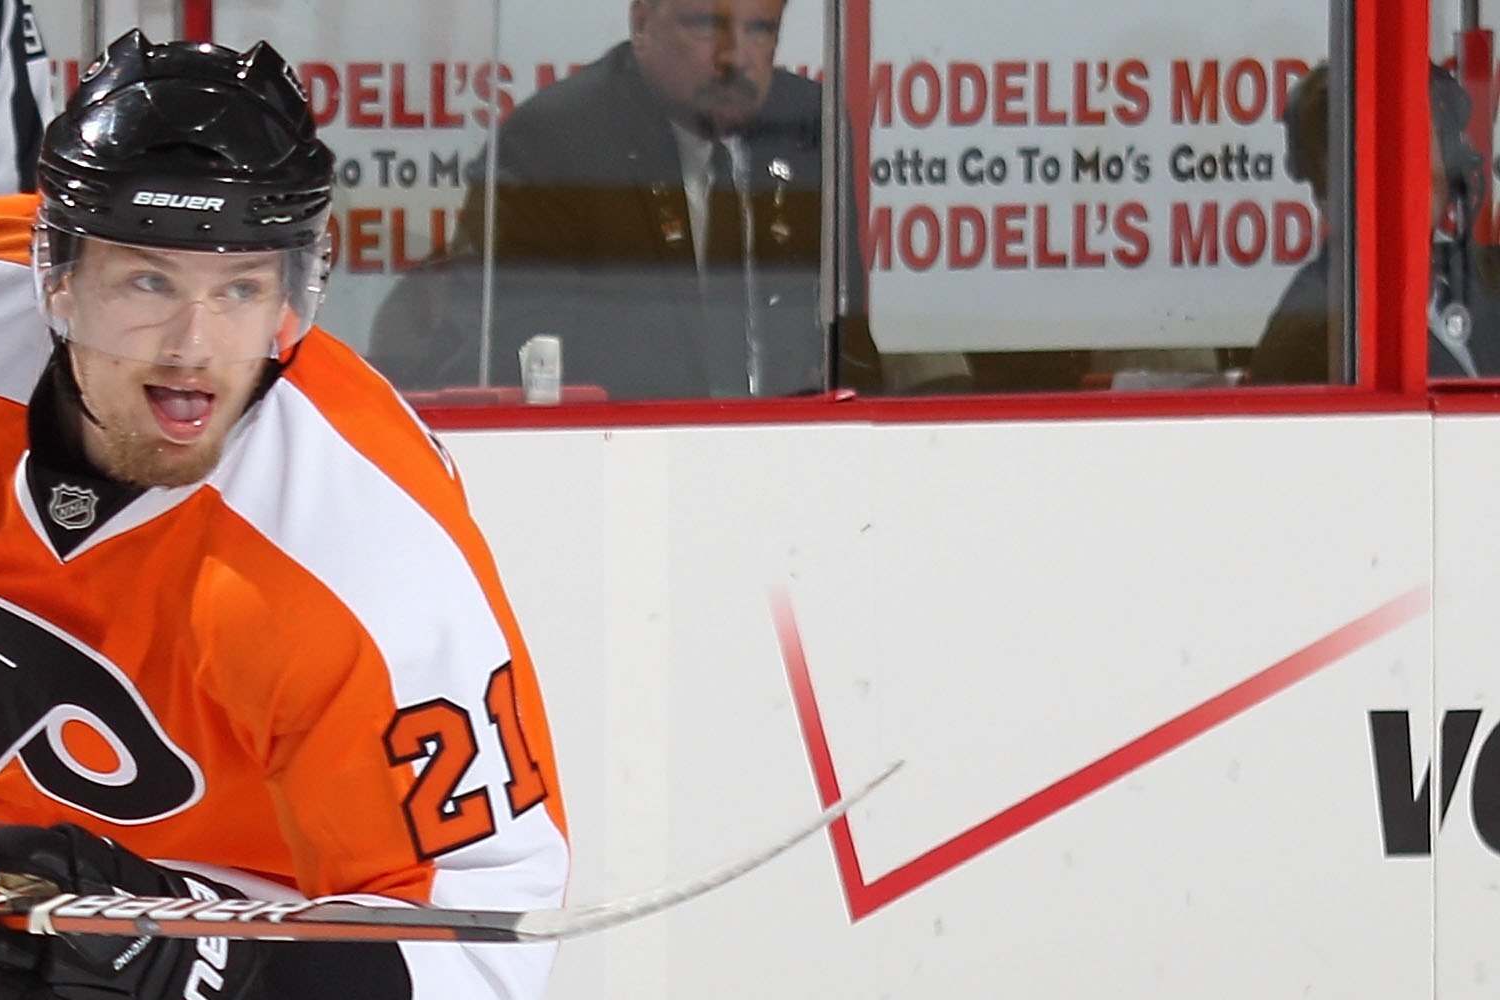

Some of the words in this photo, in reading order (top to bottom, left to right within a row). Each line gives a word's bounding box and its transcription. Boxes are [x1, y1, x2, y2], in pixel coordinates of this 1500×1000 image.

[299, 62, 517, 129] DELL'S
[373, 150, 417, 188] To
[870, 149, 946, 185] otta
[959, 147, 1007, 186] Go
[1018, 147, 1061, 184] To
[1074, 145, 1150, 184] Mo's
[1170, 144, 1273, 182] Gotta
[382, 660, 548, 862] 21
